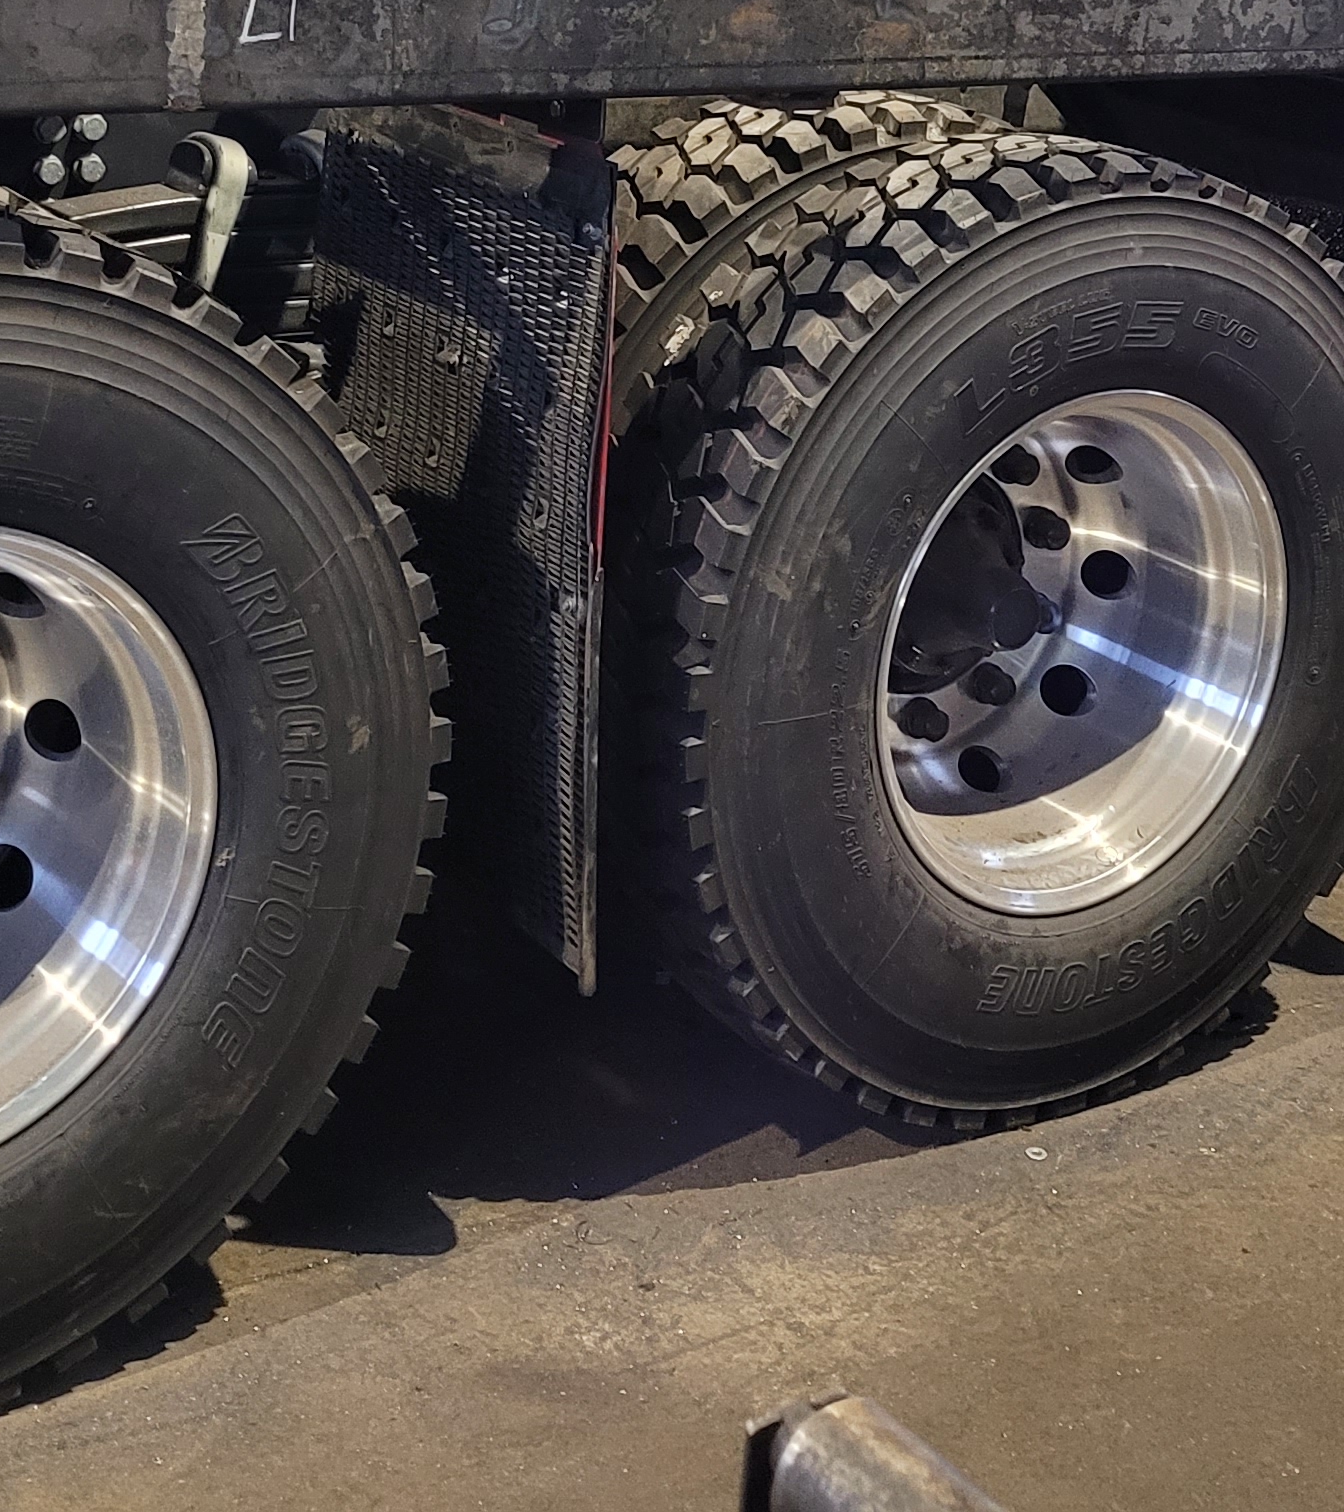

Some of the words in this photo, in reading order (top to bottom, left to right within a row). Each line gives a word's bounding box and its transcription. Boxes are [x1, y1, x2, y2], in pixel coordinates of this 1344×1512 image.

[954, 300, 1186, 437] L355
[1192, 308, 1259, 350] EVO
[179, 510, 332, 1071] BRIDGESTONE
[976, 752, 1320, 1016] BRIDGESTONE
